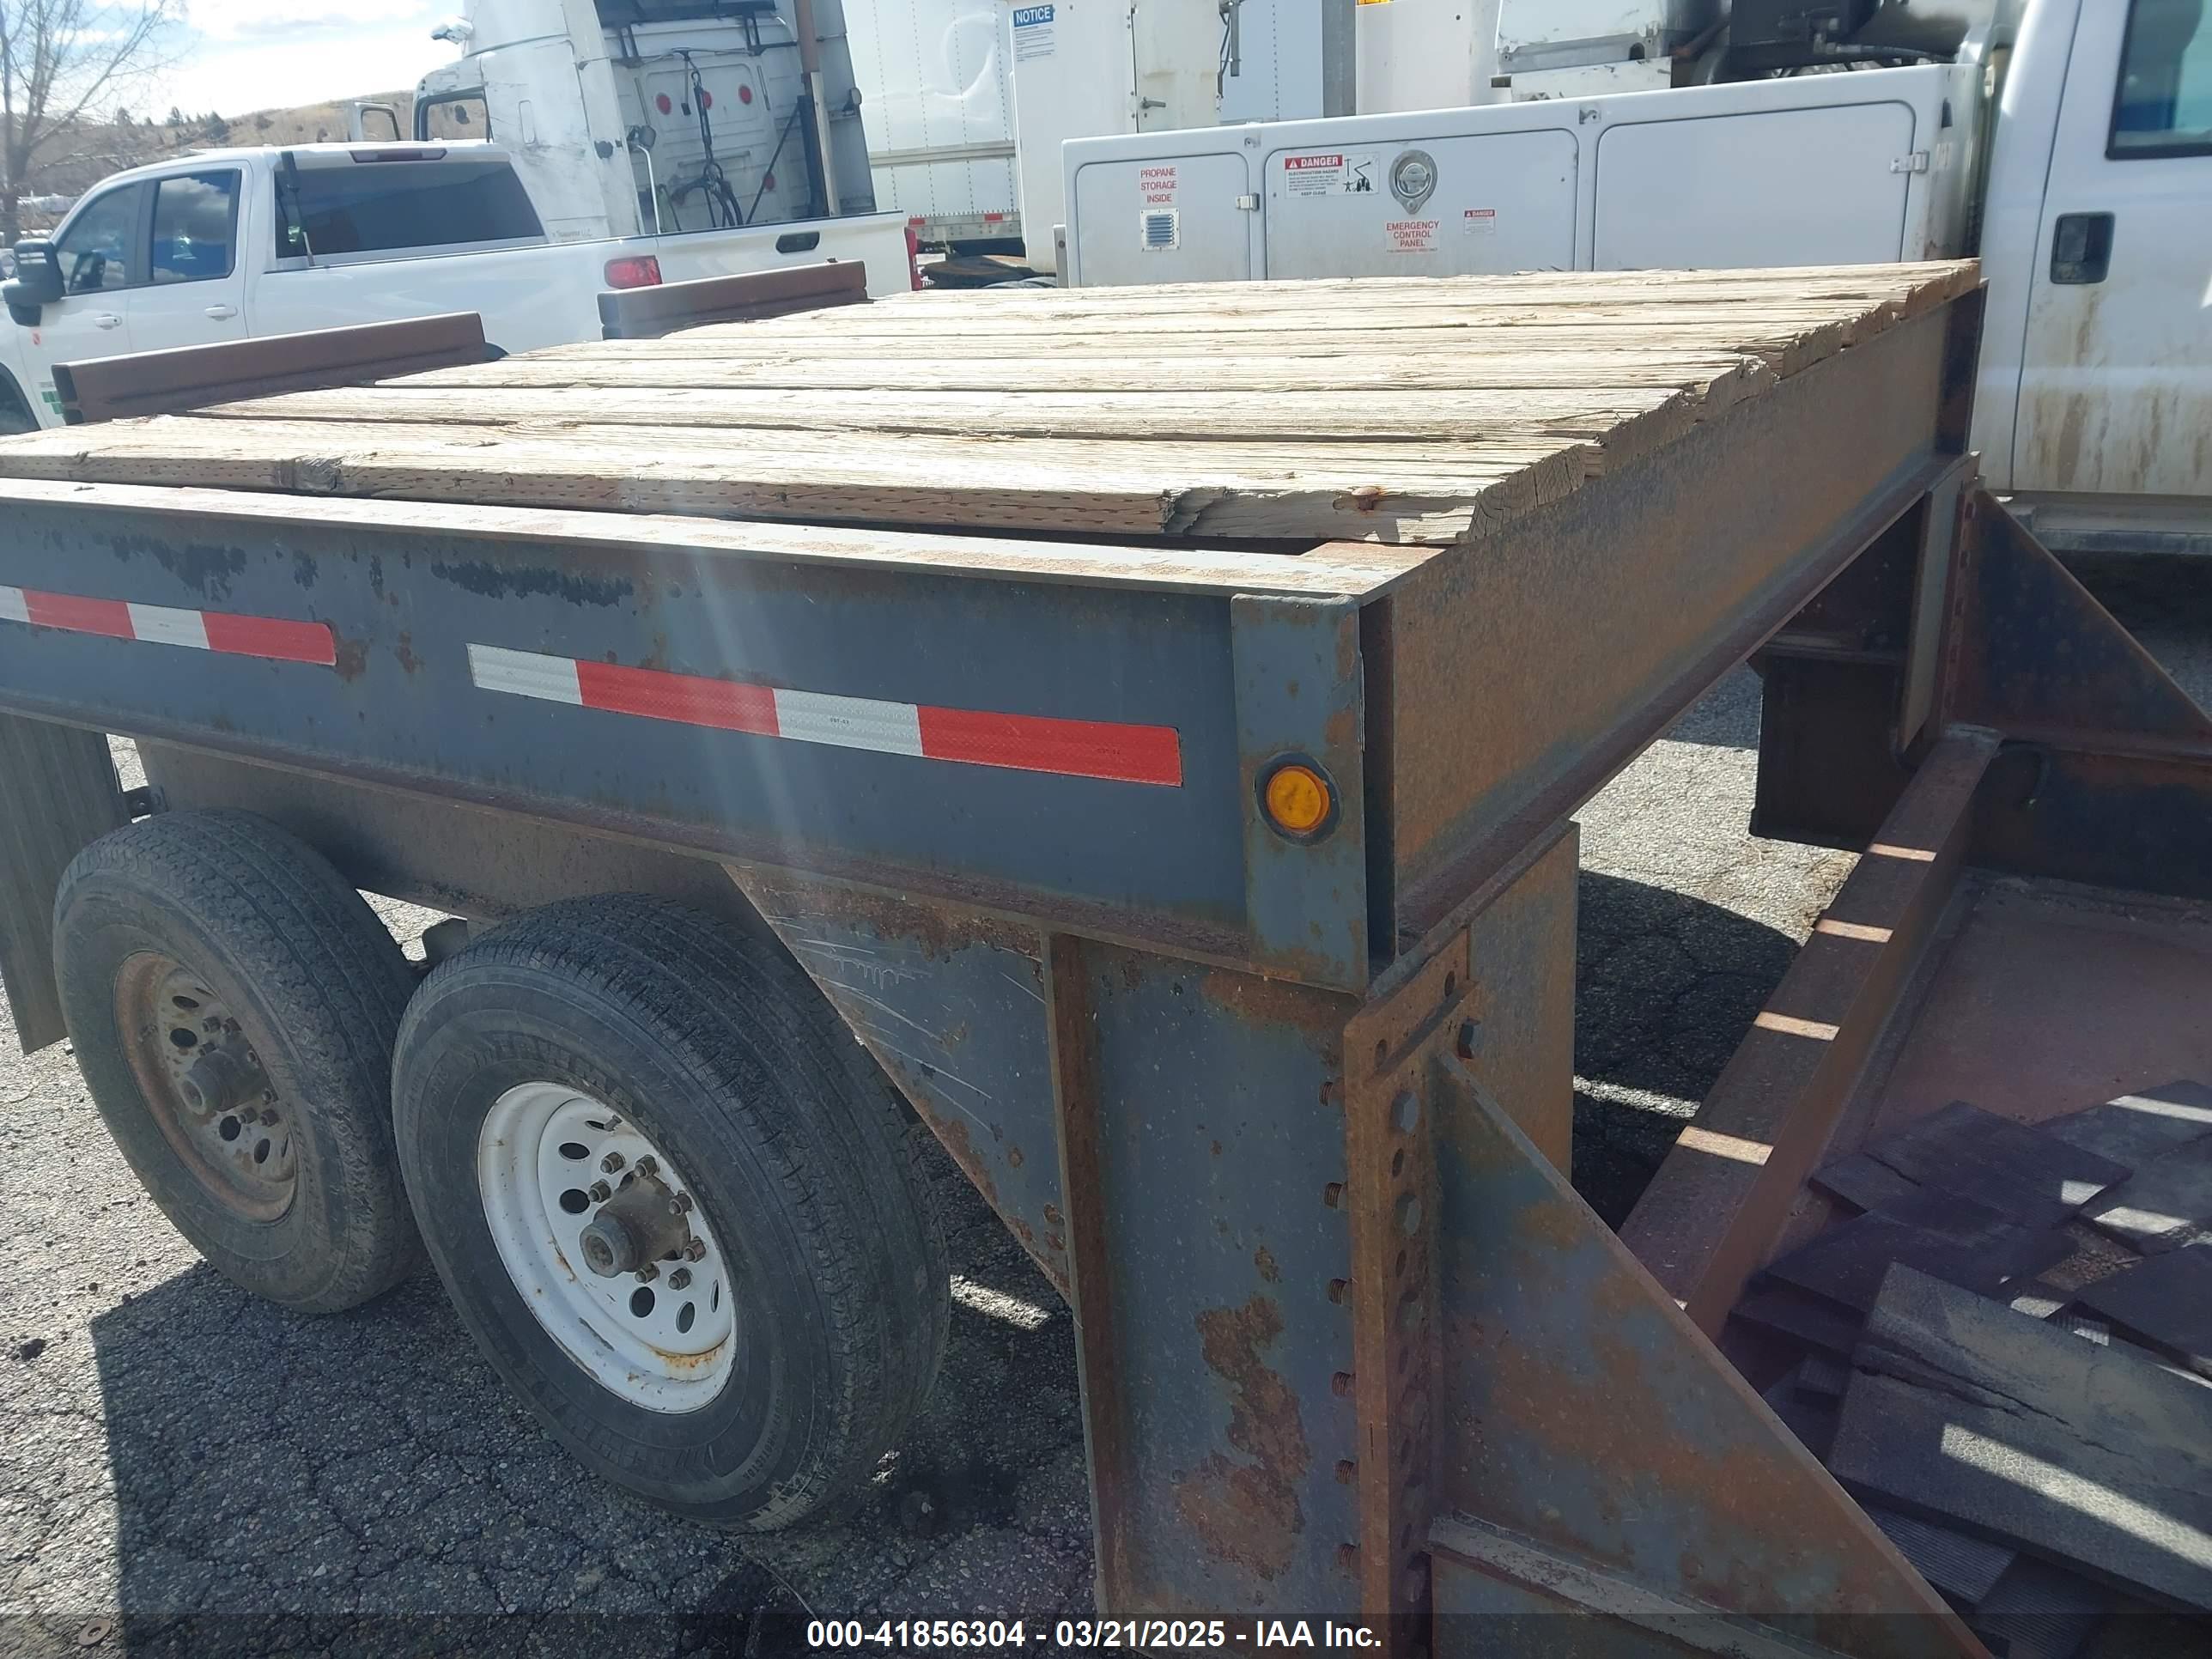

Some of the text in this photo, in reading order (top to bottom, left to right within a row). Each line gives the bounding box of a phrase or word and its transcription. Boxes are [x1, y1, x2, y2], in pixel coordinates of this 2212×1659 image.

[1016, 7, 1051, 23] NOTICE
[1300, 156, 1339, 167] DANGER
[1140, 167, 1176, 178] PROPANE
[1140, 180, 1177, 191] STORAGE
[1146, 193, 1173, 203] INSIDE
[1386, 221, 1439, 231] EMERGENCY
[1394, 230, 1432, 240] CONTROL
